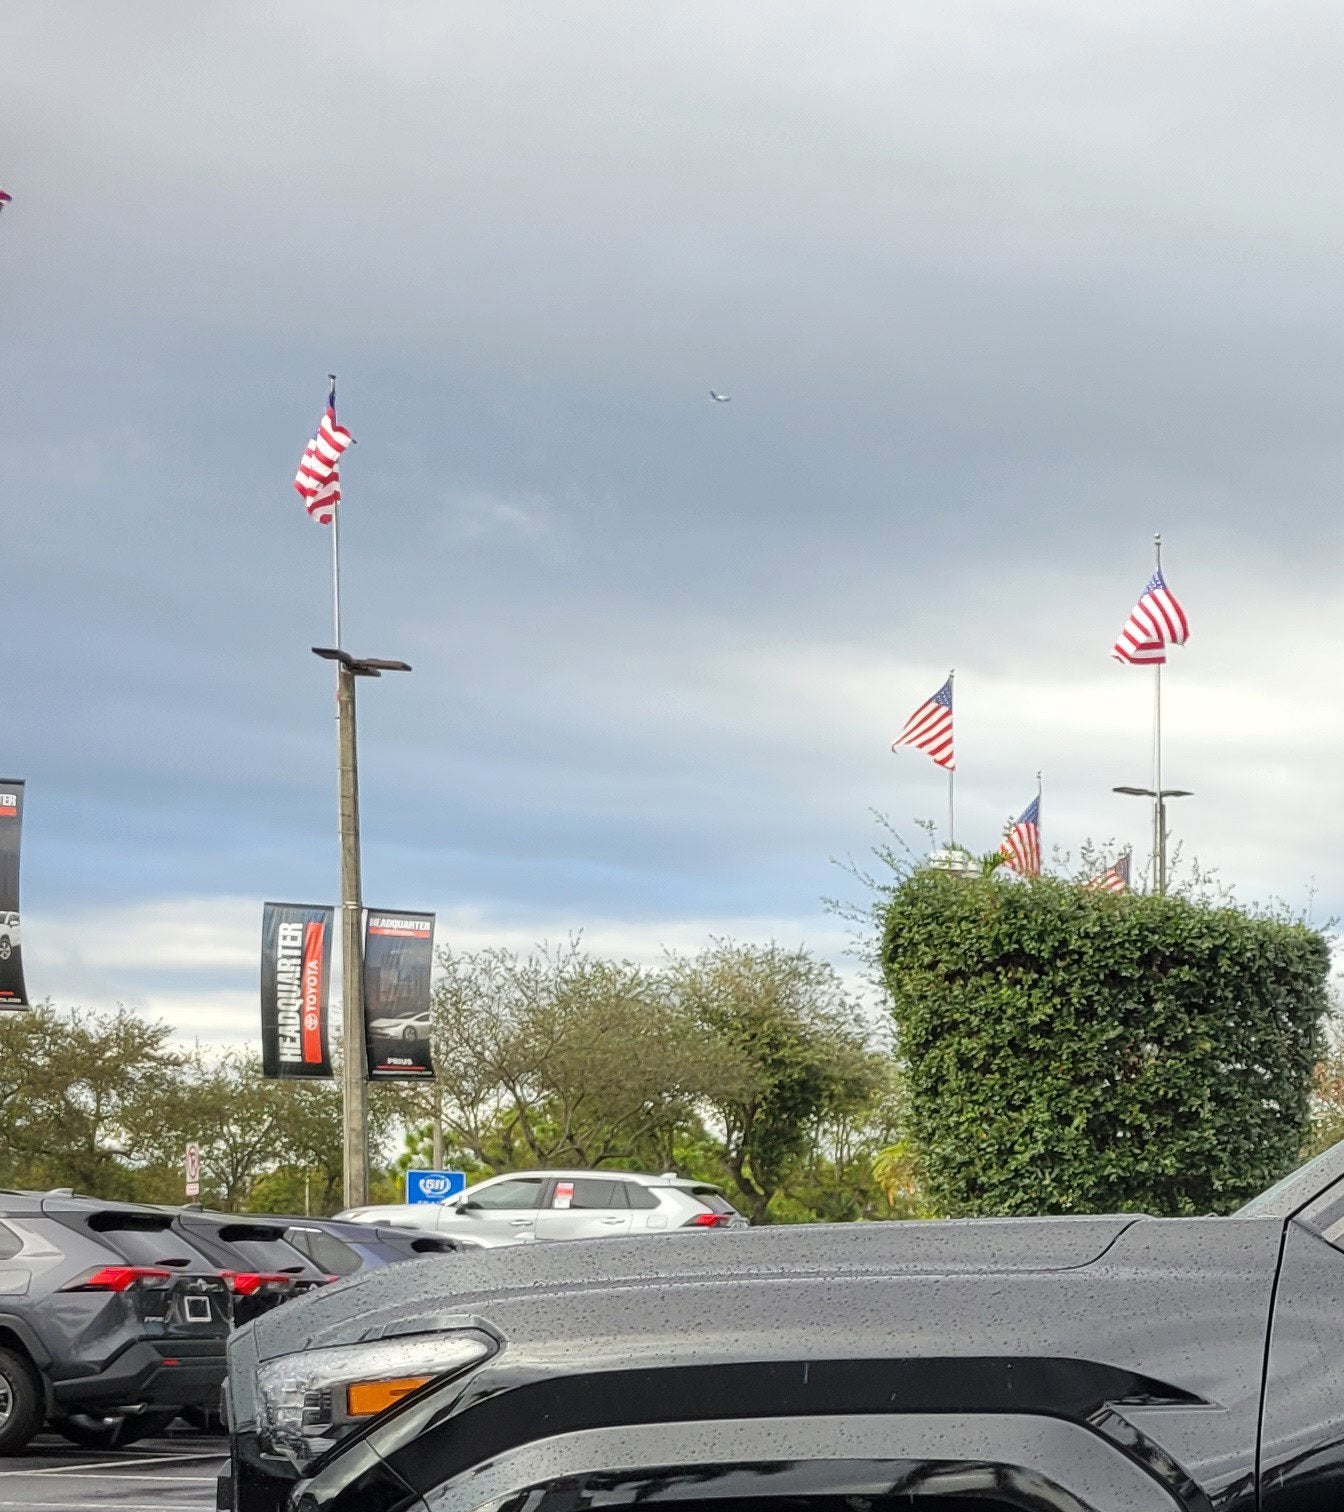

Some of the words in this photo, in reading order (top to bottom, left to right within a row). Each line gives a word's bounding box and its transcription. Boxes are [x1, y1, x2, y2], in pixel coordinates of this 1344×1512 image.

[368, 917, 432, 931] HEADQUARTER
[276, 922, 304, 1063] HEADQUARTER
[305, 959, 320, 1011] TOYOTA
